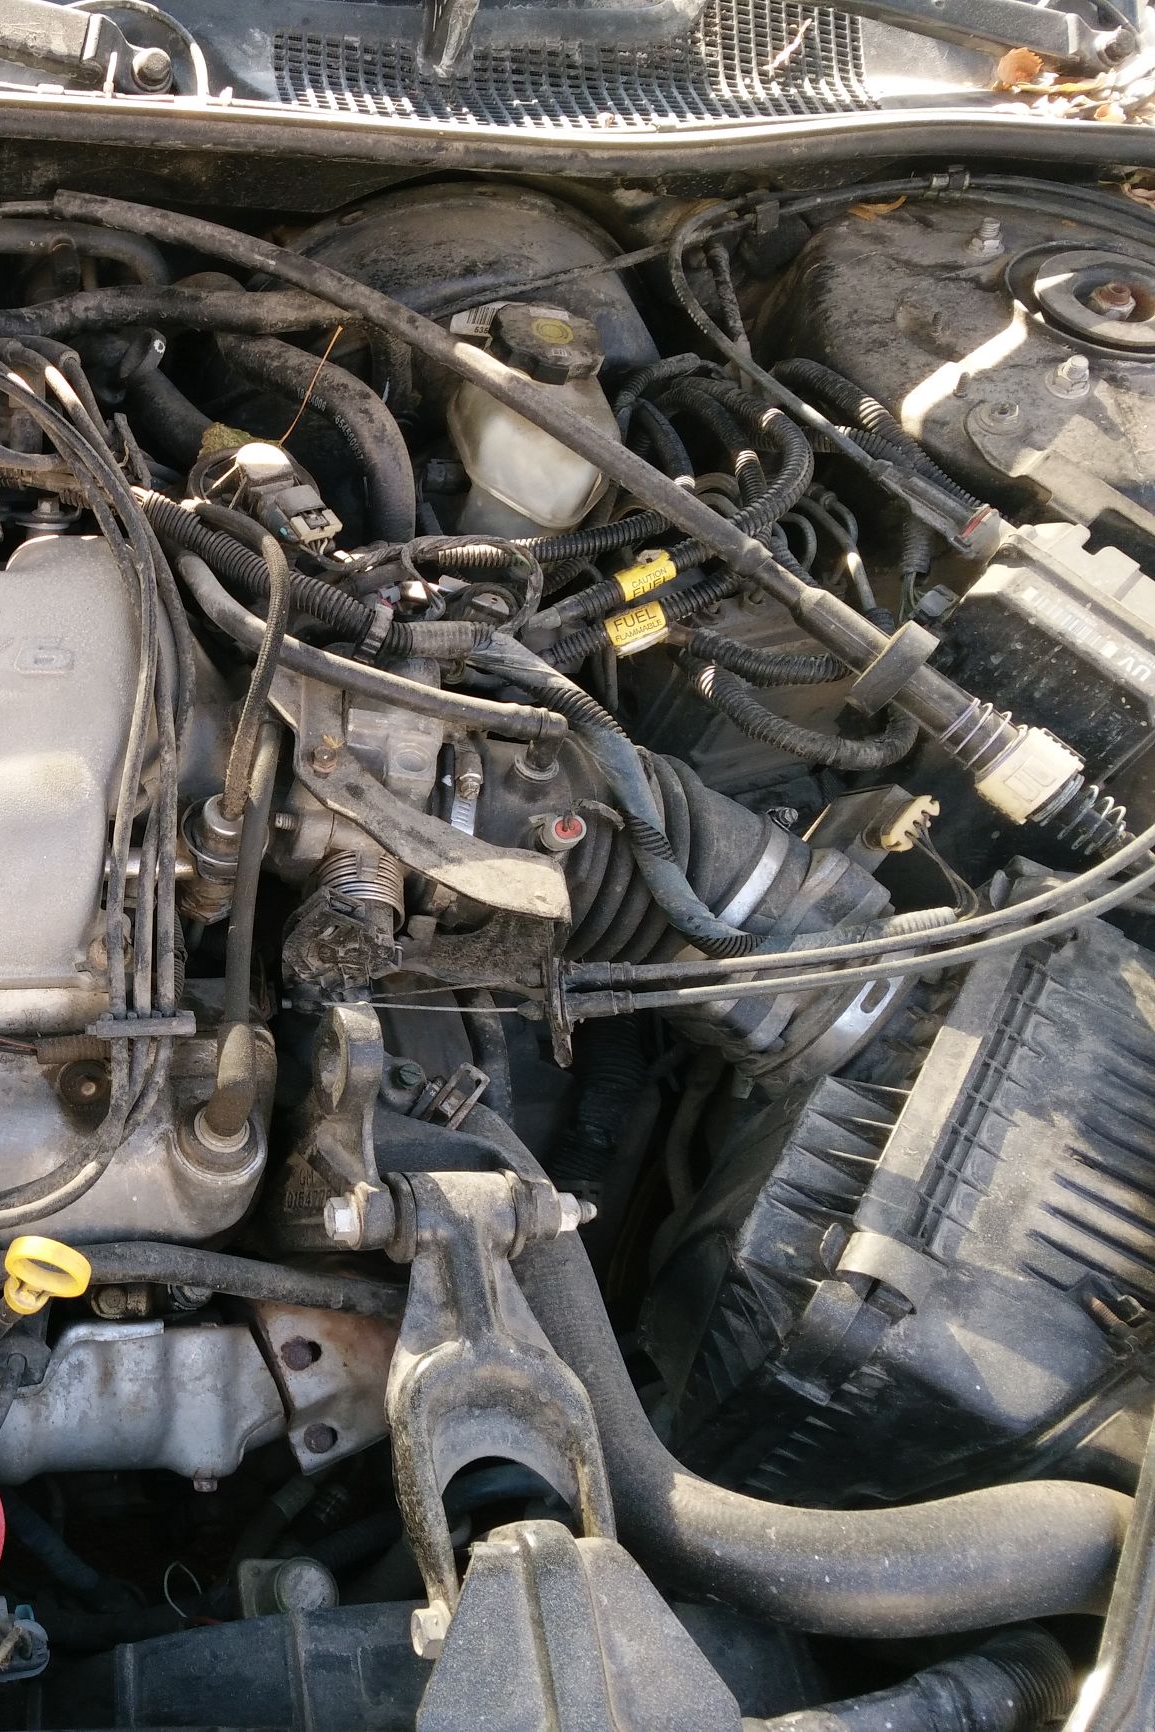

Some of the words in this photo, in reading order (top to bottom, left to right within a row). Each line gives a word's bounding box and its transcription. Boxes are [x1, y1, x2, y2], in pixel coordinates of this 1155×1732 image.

[631, 566, 667, 589] CAUTION
[613, 608, 657, 632] FUEL
[615, 619, 663, 642] FLAMMABLE
